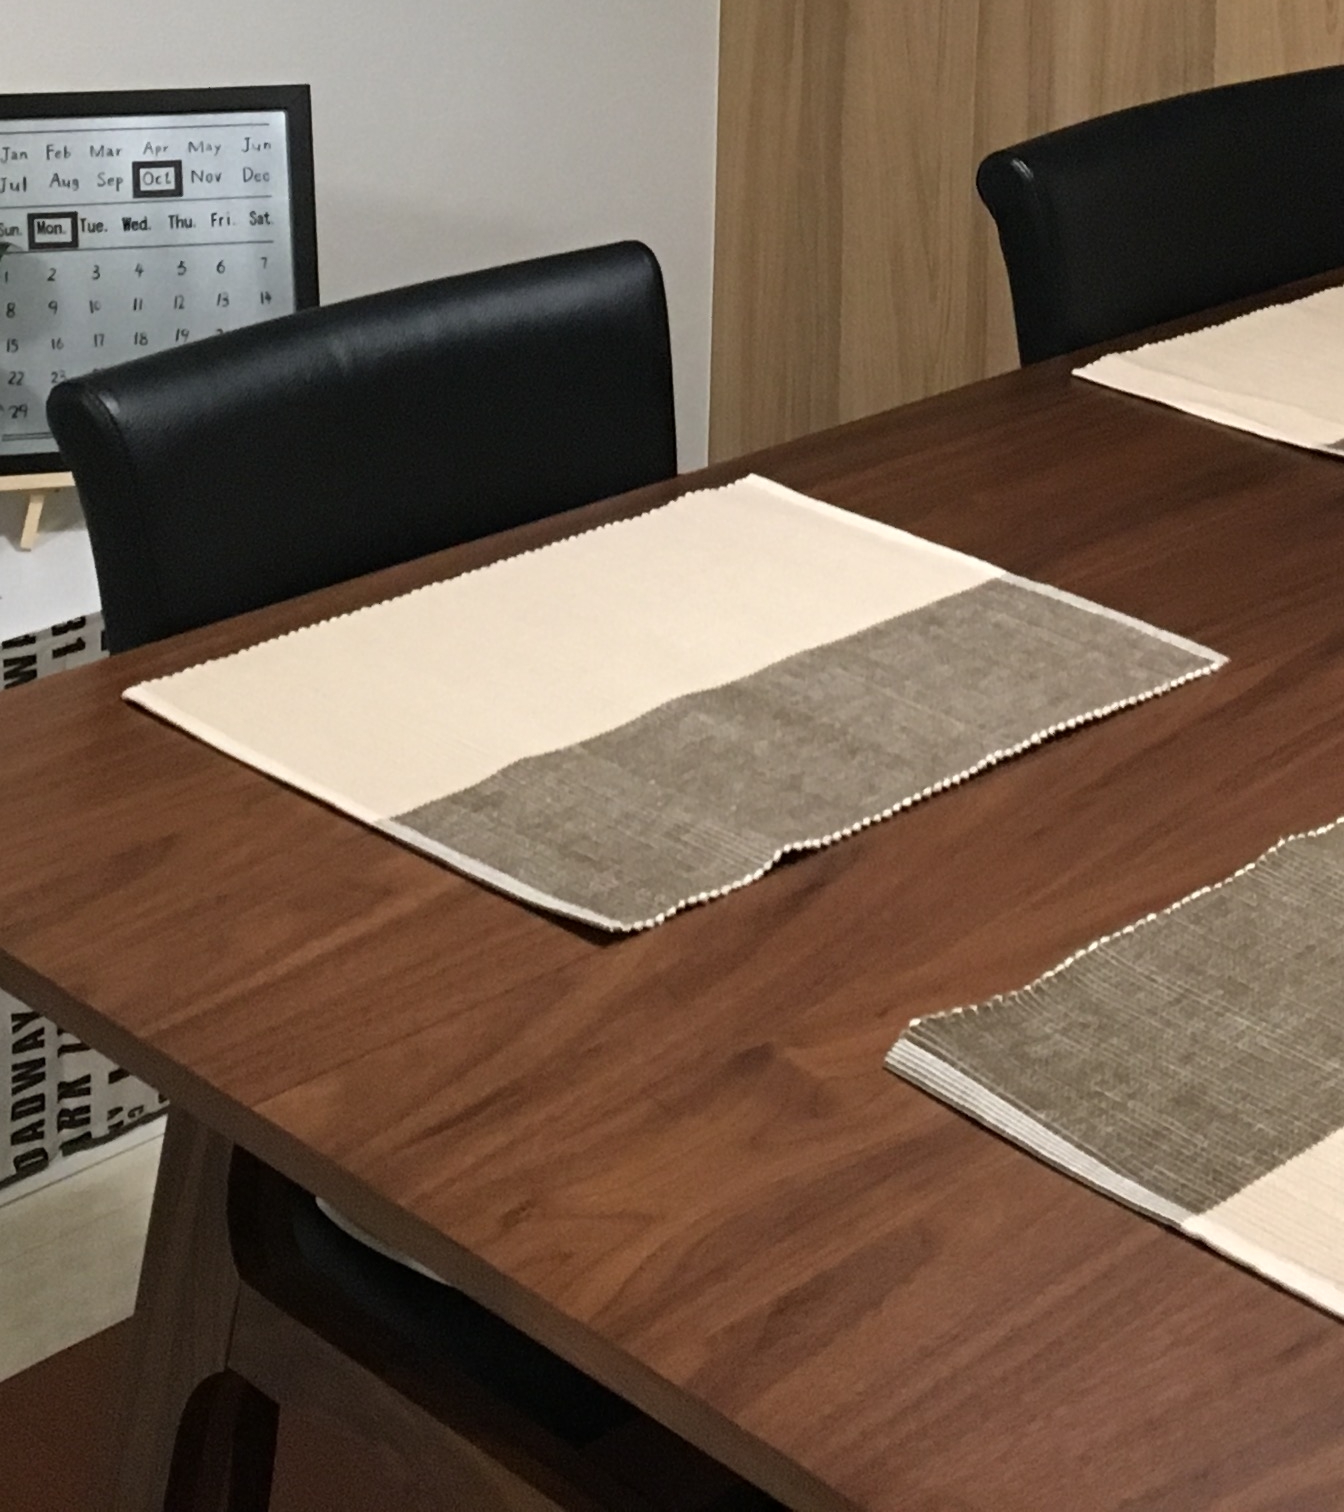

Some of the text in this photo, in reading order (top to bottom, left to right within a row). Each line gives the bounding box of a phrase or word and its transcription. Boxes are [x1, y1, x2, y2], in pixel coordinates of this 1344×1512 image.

[0, 137, 272, 164] Jan Feb Mar Apr May Jun
[49, 173, 80, 191] Aug
[97, 172, 124, 192] Sep
[142, 171, 173, 186] Oct
[191, 169, 222, 184] Nov
[242, 167, 270, 183] Dec
[37, 221, 66, 235] Mon.
[80, 217, 108, 233] Tue.
[121, 217, 151, 232] Wed.
[168, 214, 196, 229] Thu.
[211, 212, 235, 227] Fri.
[47, 260, 225, 282] 2 3 4 5 6
[6, 291, 272, 318] 8 9 10 11 12 13 14
[6, 327, 189, 353] 15 17 18 19
[8, 371, 24, 386] 22
[8, 403, 28, 419] 29
